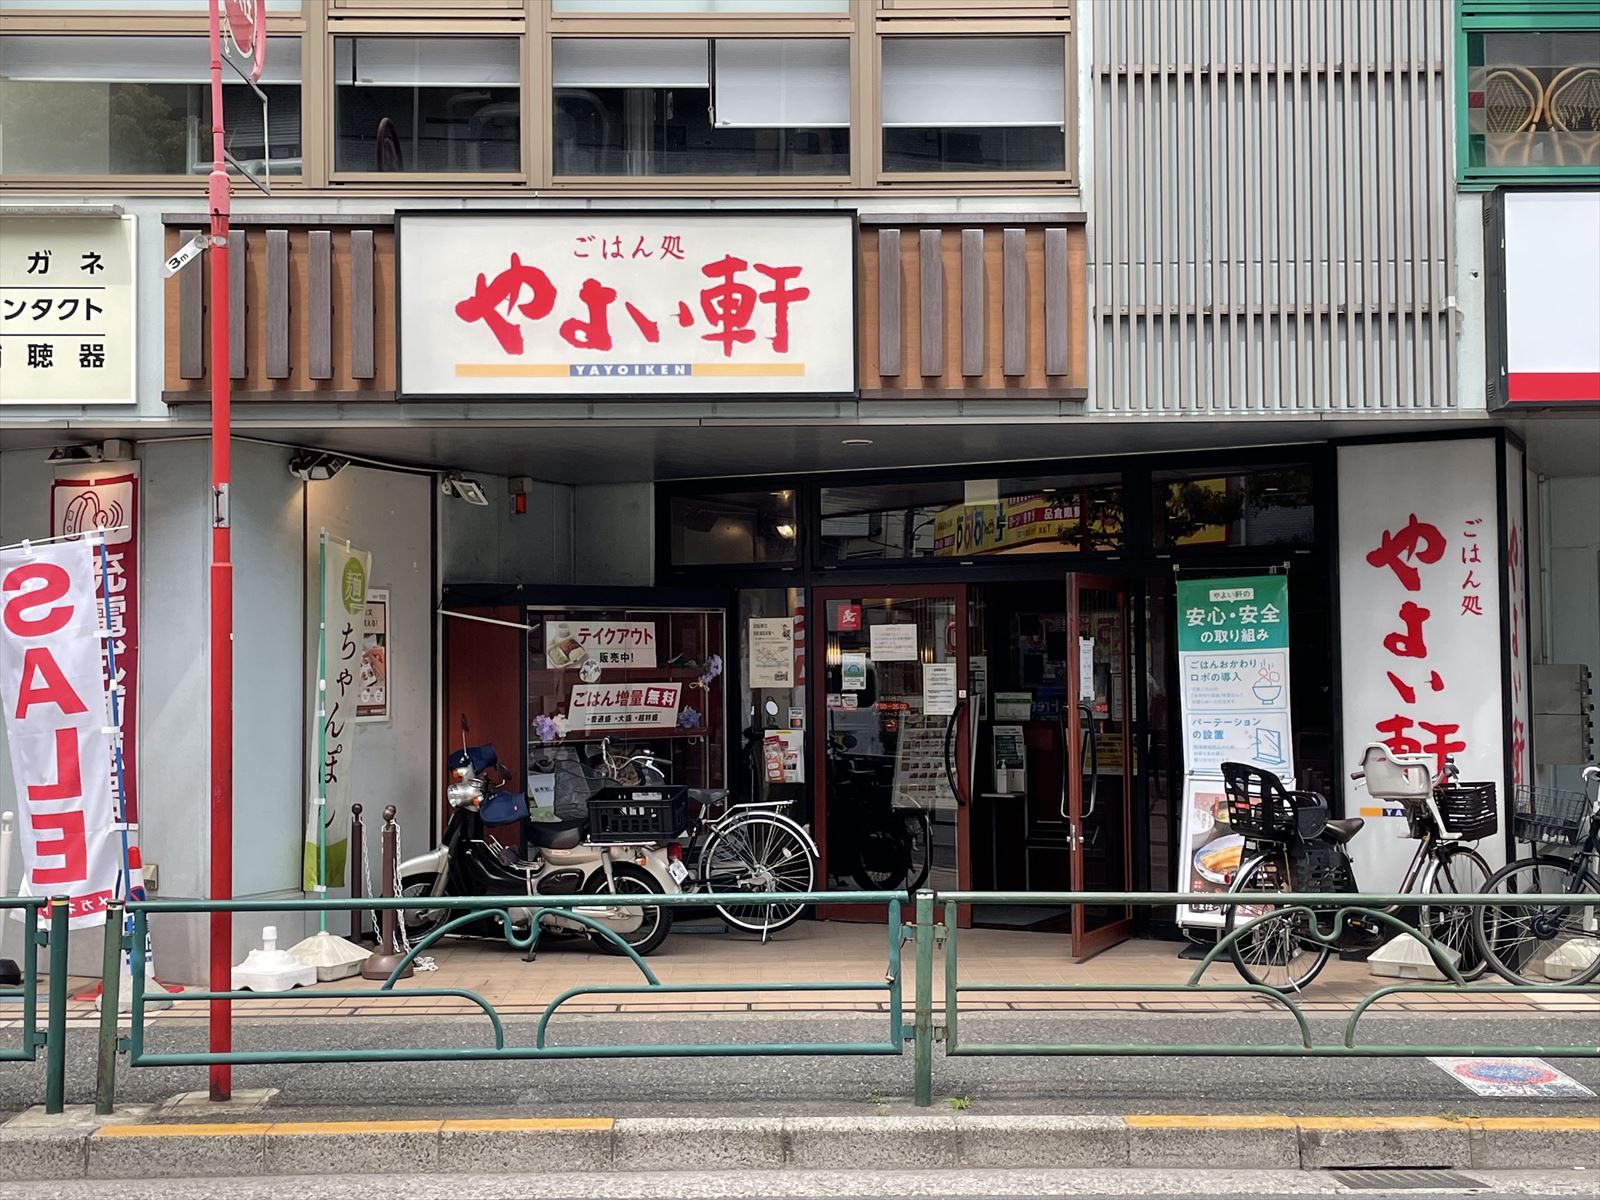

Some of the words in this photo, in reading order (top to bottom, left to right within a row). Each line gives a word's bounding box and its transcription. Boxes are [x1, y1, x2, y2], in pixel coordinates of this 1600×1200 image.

[573, 235, 685, 261] ごはん処
[169, 253, 189, 269] 3m
[4, 298, 105, 321] ンタクト
[455, 252, 811, 357] やよい軒
[0, 343, 106, 369] 聴器
[575, 364, 687, 376] YAYOIKEN
[1460, 517, 1484, 616] ごはん処
[1213, 591, 1251, 599] やよい軒の
[1186, 603, 1280, 627] 安心・安全
[578, 627, 653, 645] テイクアウト
[1200, 629, 1269, 643] の取り組み
[599, 652, 634, 664] 販売中!
[1190, 658, 1257, 670] ごはんおかわり
[1190, 671, 1242, 683] ロボの導入
[573, 690, 643, 708] ごはん増量
[646, 689, 676, 706] 無料
[1192, 730, 1225, 740] の設置
